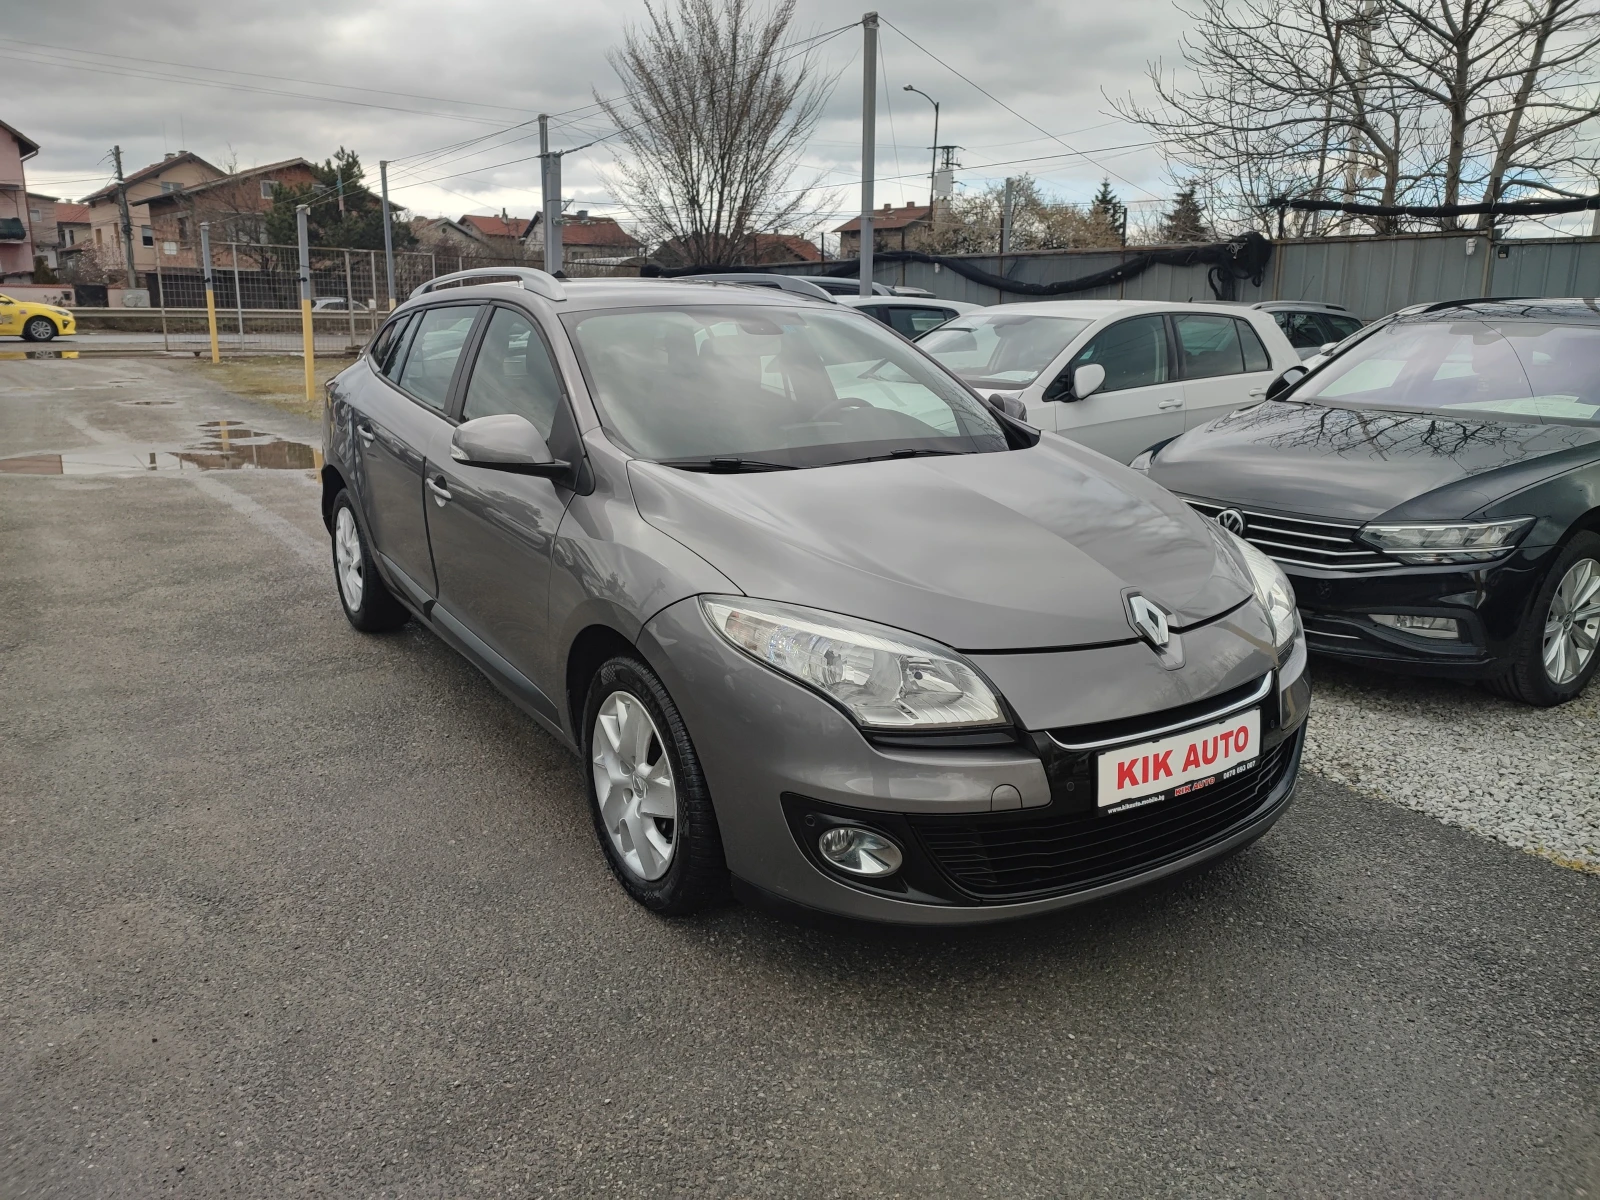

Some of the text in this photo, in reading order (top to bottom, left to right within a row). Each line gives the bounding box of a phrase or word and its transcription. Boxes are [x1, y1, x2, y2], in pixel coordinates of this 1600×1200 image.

[1117, 725, 1249, 790] KIK AUTO
[1174, 776, 1216, 797] KIK AUTO
